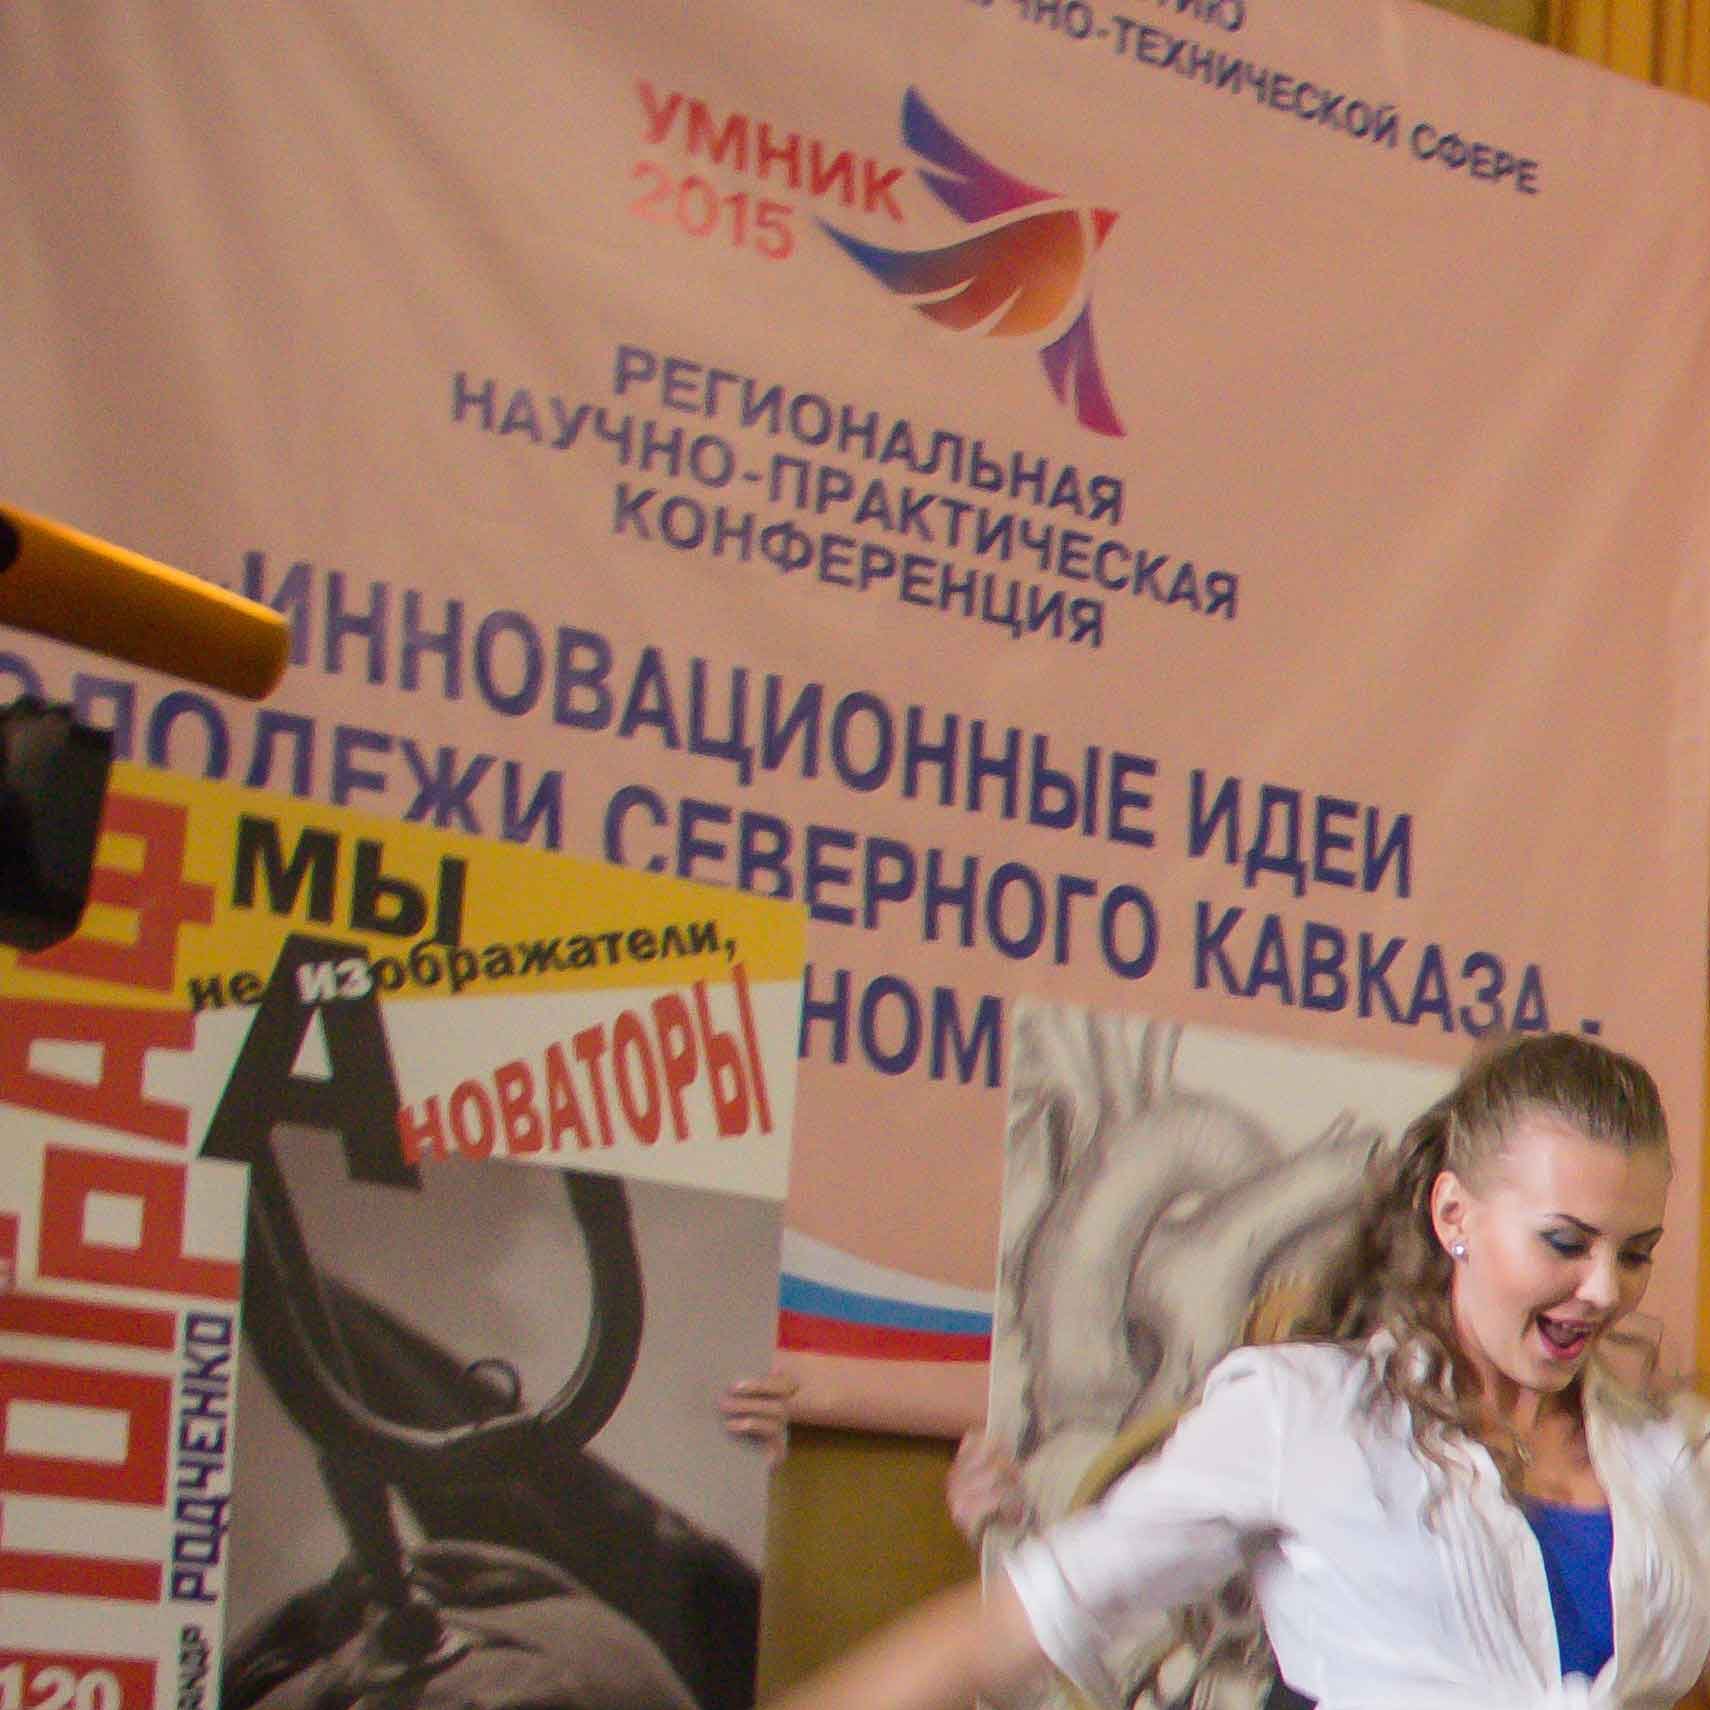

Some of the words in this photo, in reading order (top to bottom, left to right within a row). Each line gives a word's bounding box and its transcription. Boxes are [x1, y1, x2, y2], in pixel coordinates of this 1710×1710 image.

[630, 160, 797, 260] 2015
[636, 79, 904, 224] УМНИК
[1409, 122, 1540, 195] СФЕРЕ
[450, 371, 1240, 620] НАУЧНО-ПРАКТИЧЕСКАЯ
[613, 343, 1125, 525] РЕГИОНАЛЬНАЯ
[612, 481, 1104, 649] КОНФЕРЕНЦИЯ
[230, 814, 468, 946] МЫ
[605, 784, 1160, 981] СЕВЕРНОГО
[1187, 768, 1414, 899] ИДЕИ
[1194, 899, 1550, 1040] КАВКАЗА
[399, 962, 774, 1163] НОВАТОРЫ
[170, 1311, 234, 1605] РОДЧЕНКО
